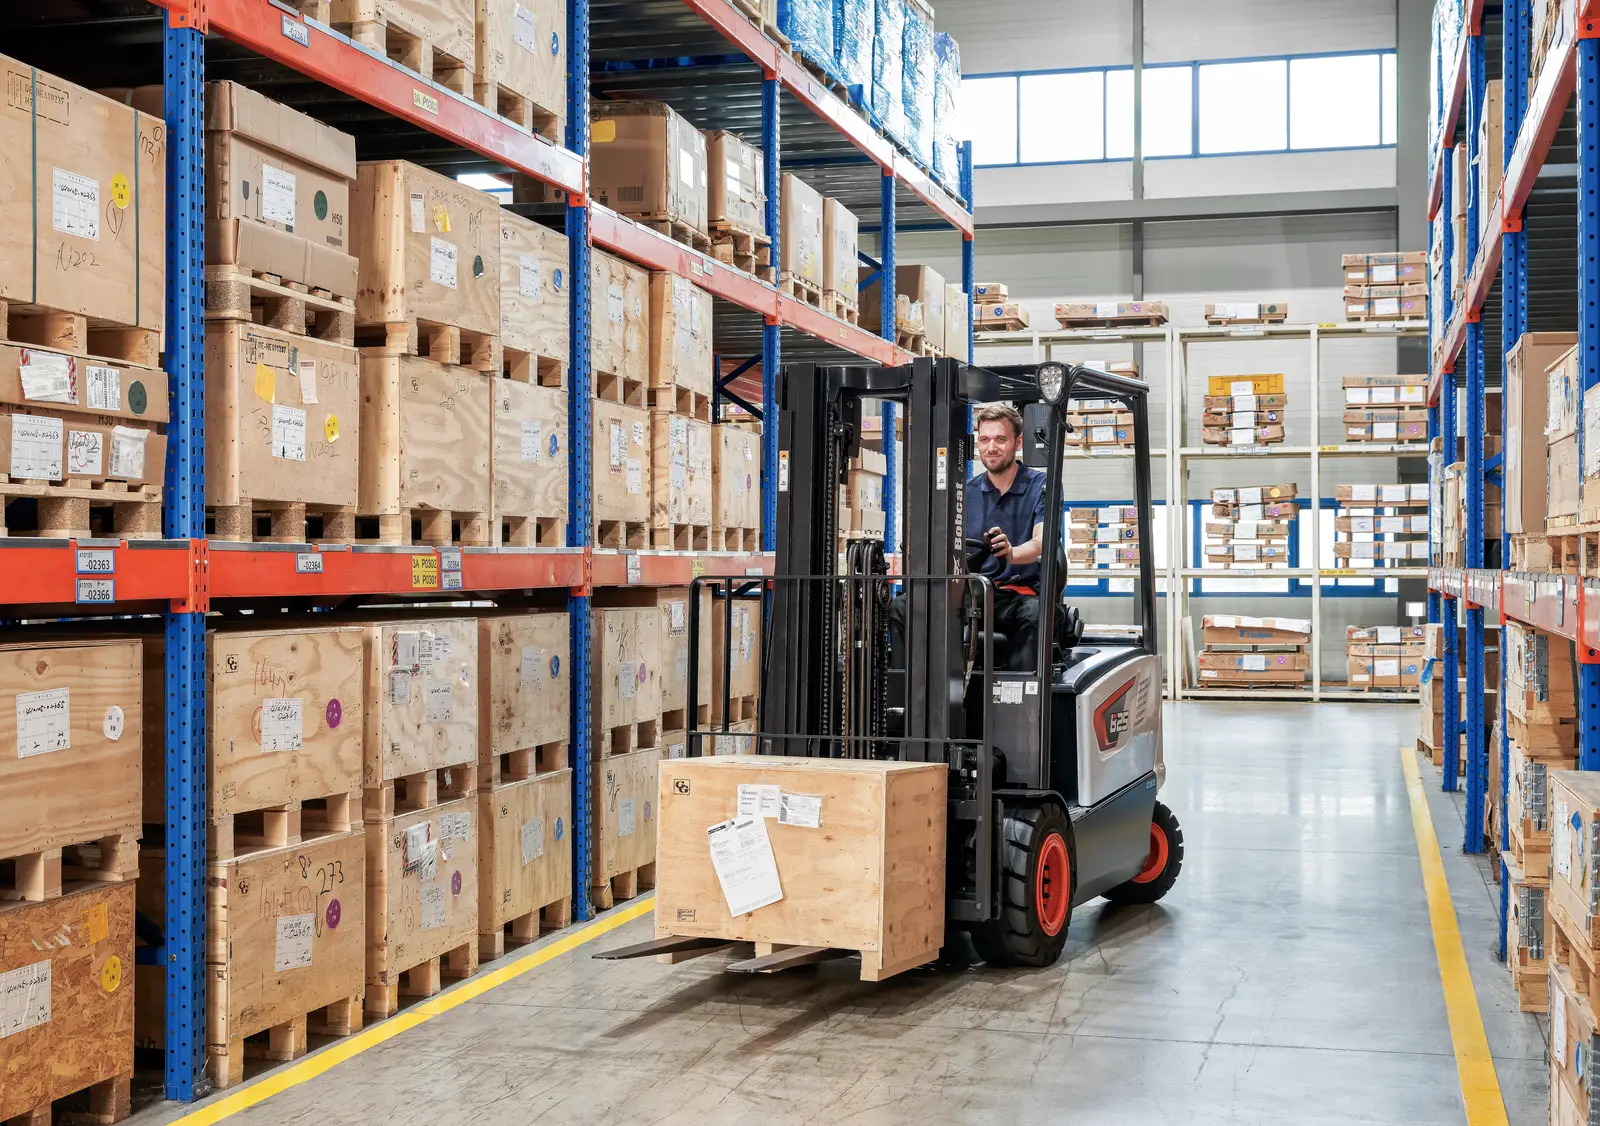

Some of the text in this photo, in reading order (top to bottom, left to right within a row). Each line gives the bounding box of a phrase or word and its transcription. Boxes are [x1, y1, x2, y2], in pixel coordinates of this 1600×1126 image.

[954, 482, 963, 551] Bobcat
[86, 560, 110, 570] -02363
[86, 590, 110, 600] -02366
